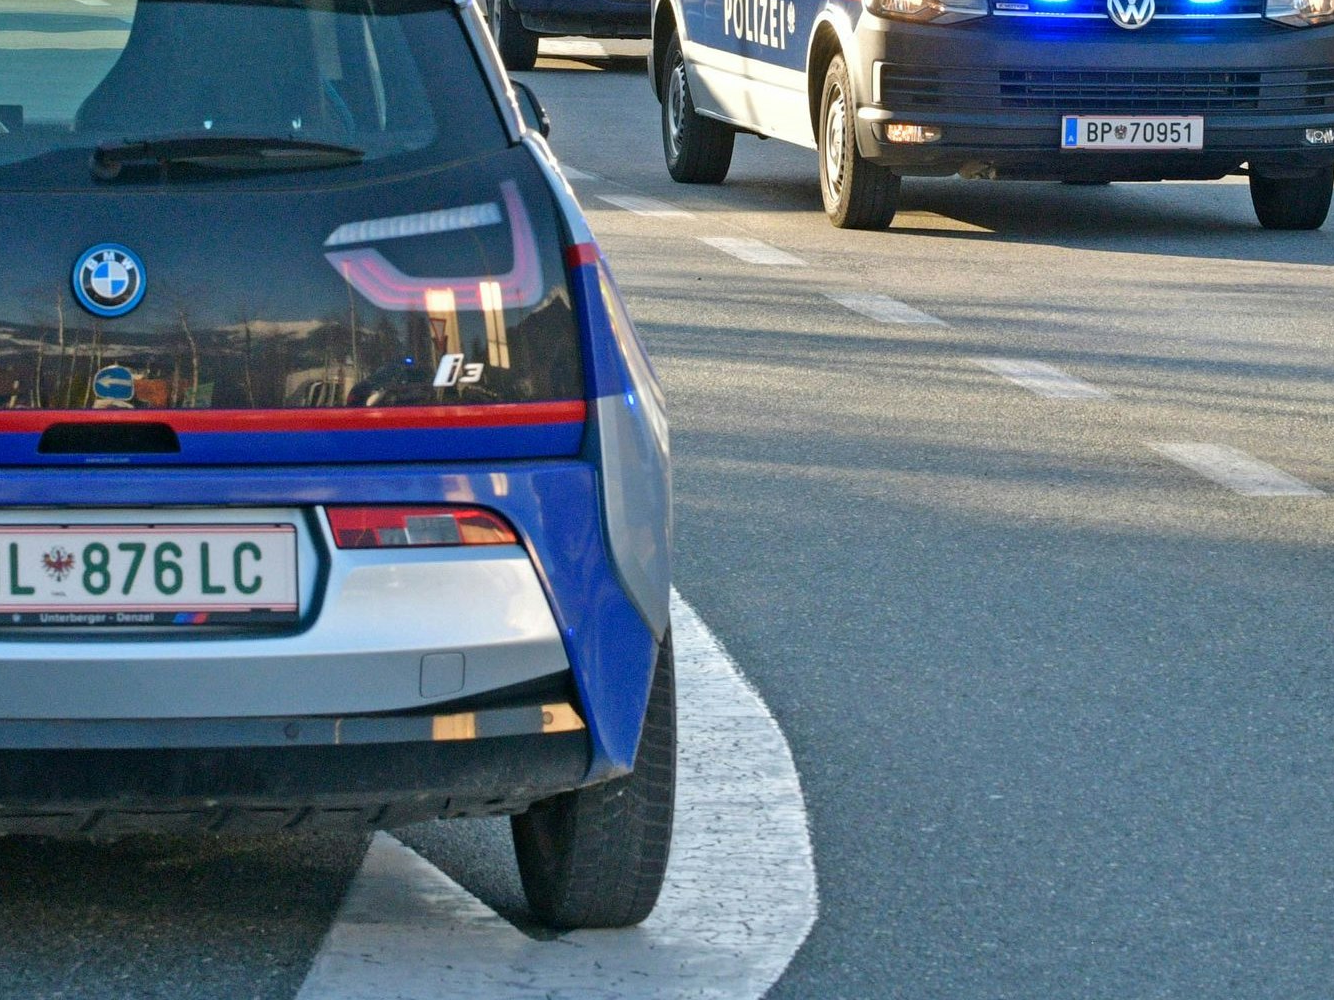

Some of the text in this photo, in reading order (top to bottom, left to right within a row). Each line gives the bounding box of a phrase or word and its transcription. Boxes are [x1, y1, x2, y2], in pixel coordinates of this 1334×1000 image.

[1087, 122, 1113, 143] BP
[1129, 122, 1192, 143] 70951
[433, 353, 484, 387] i3
[39, 612, 107, 625] Unterberger
[117, 612, 155, 624] Denzel
